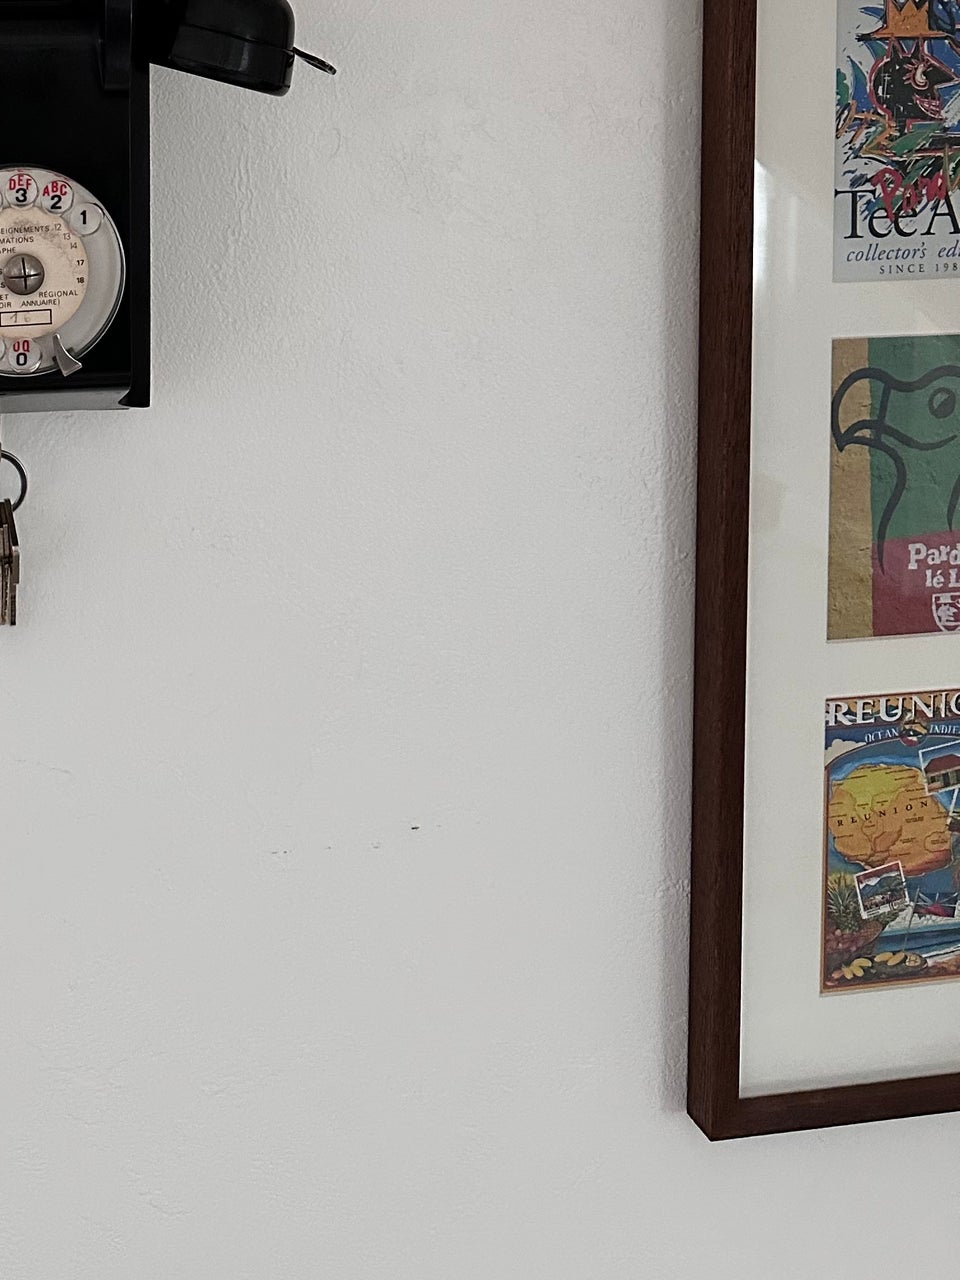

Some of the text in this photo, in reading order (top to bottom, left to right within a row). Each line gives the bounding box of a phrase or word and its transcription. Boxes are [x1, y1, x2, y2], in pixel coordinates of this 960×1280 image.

[9, 173, 32, 191] DEF
[42, 180, 67, 196] ABC
[15, 187, 28, 203] 3
[50, 194, 62, 210] 2
[80, 210, 88, 225] 1
[54, 223, 62, 232] 12
[63, 232, 71, 241] 13
[70, 242, 78, 250] 14
[846, 239, 960, 262] collector's ed
[77, 259, 85, 267] 17
[879, 264, 926, 274] SINCE
[76, 277, 85, 285] 18
[0, 293, 9, 301] ET
[38, 289, 79, 299] RÉGIONAL
[21, 298, 61, 308] ANNUAIRE)
[16, 352, 28, 366] 0
[925, 568, 944, 588] lé
